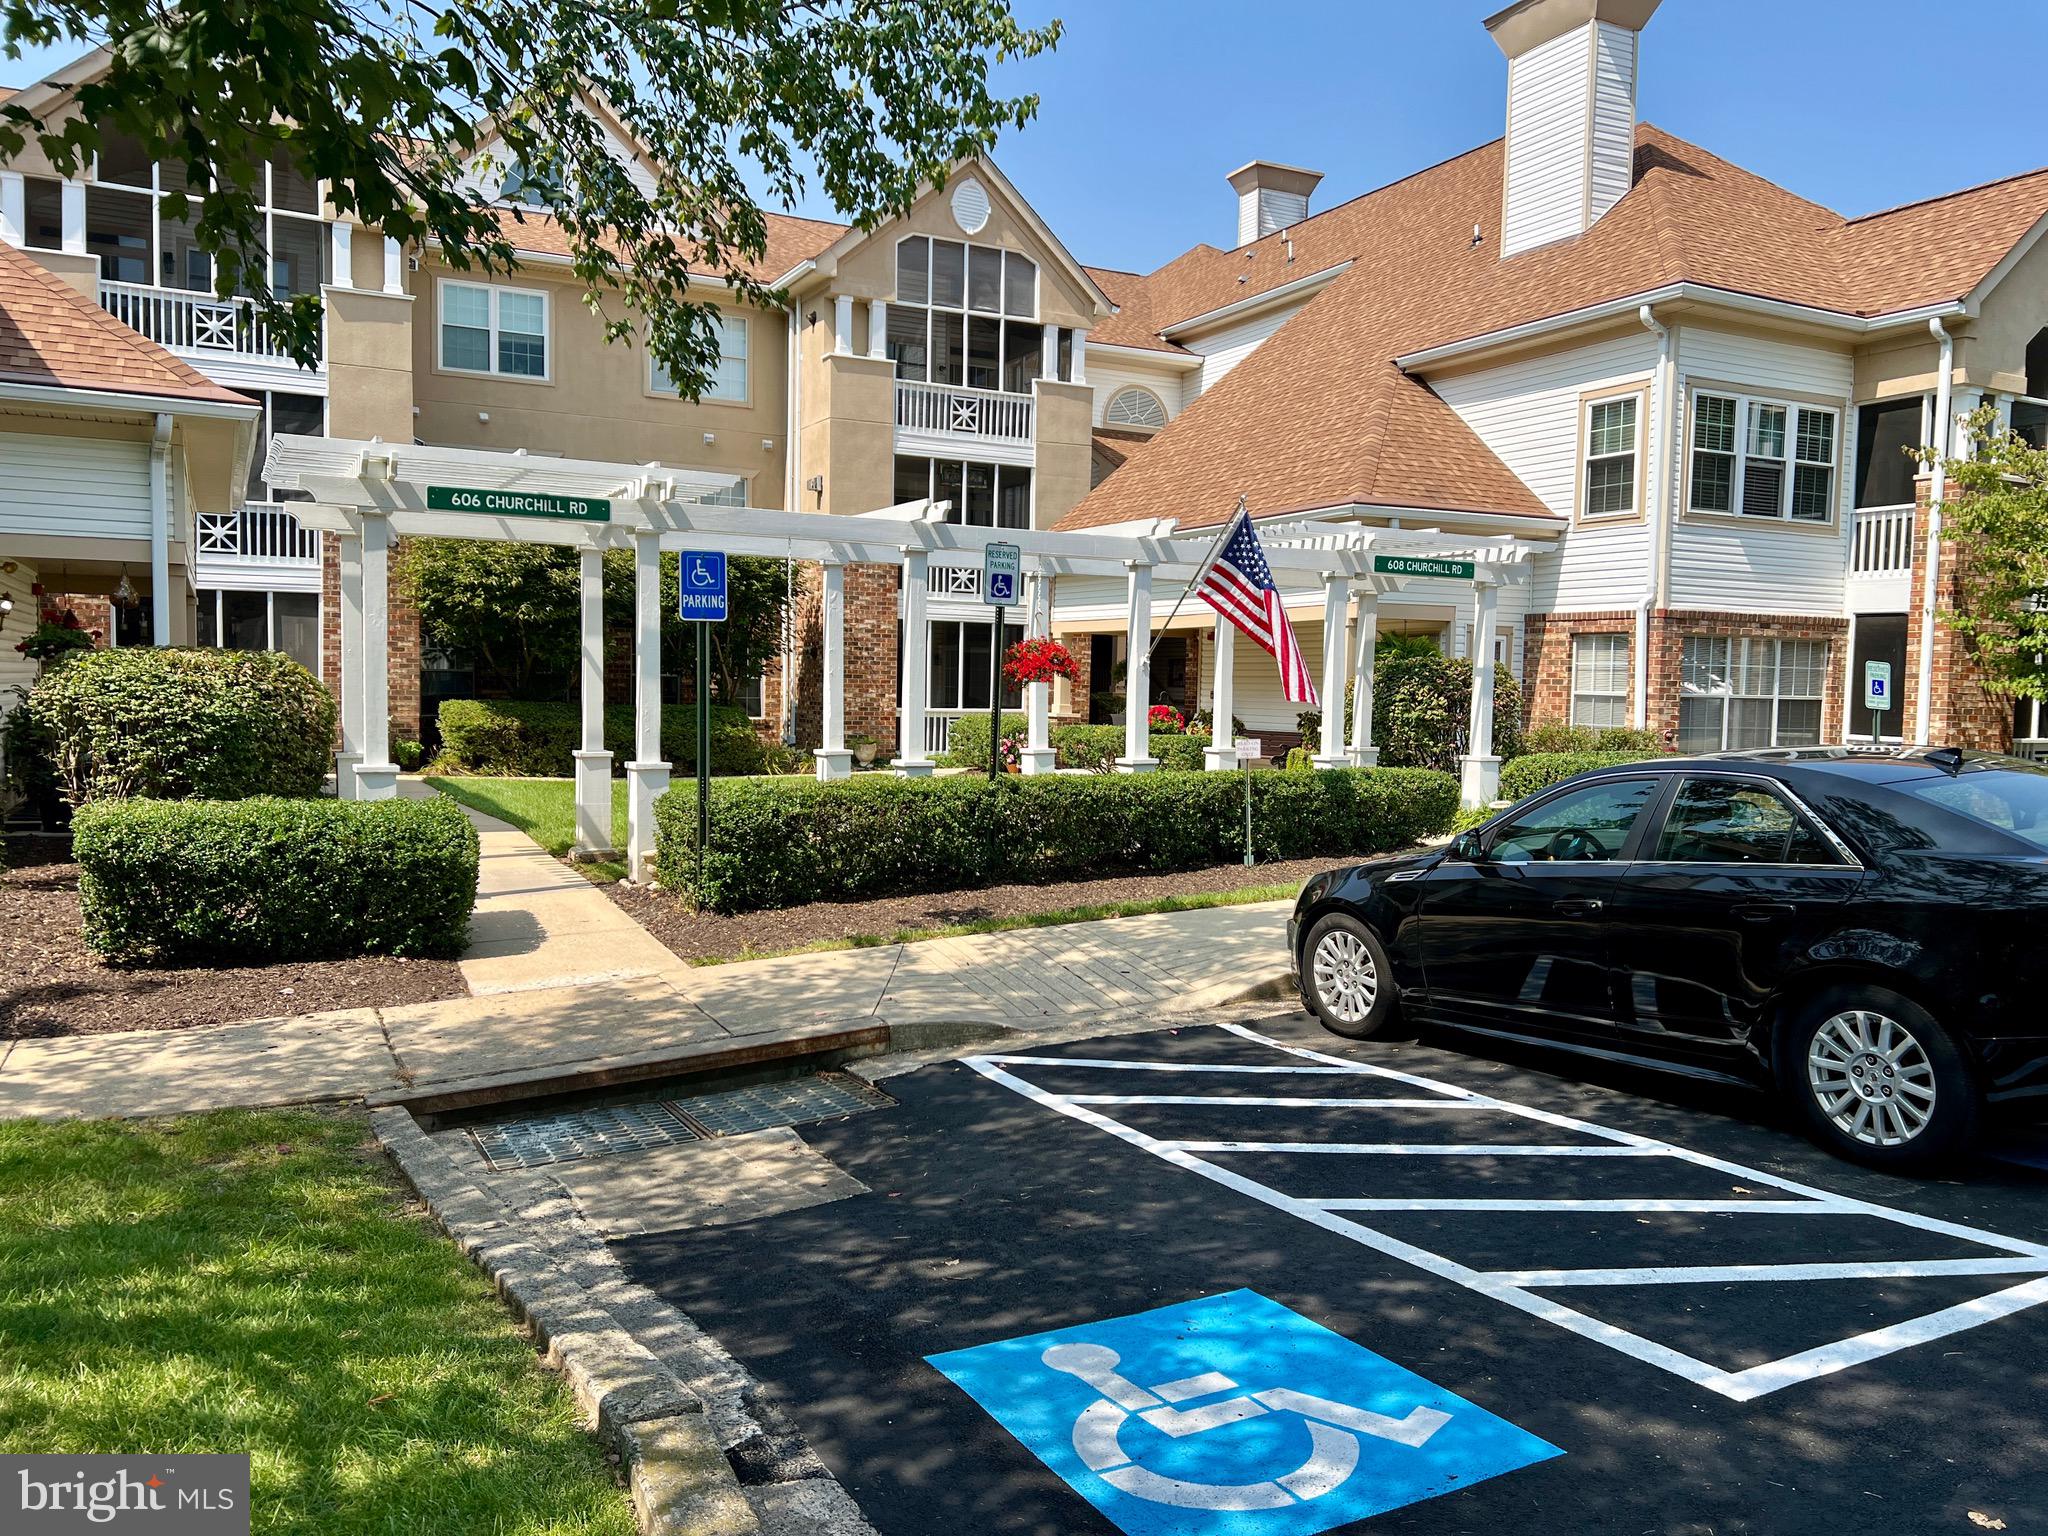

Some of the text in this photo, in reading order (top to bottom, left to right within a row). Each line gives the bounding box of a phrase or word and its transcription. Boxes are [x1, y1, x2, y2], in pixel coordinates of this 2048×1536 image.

[451, 493, 588, 515] 606 CHURCHILL RD
[988, 550, 1018, 560] RESERVED
[990, 561, 1015, 571] PARKING
[1387, 560, 1463, 575] 608 CHURCHILL RD
[682, 594, 725, 609] PARKING
